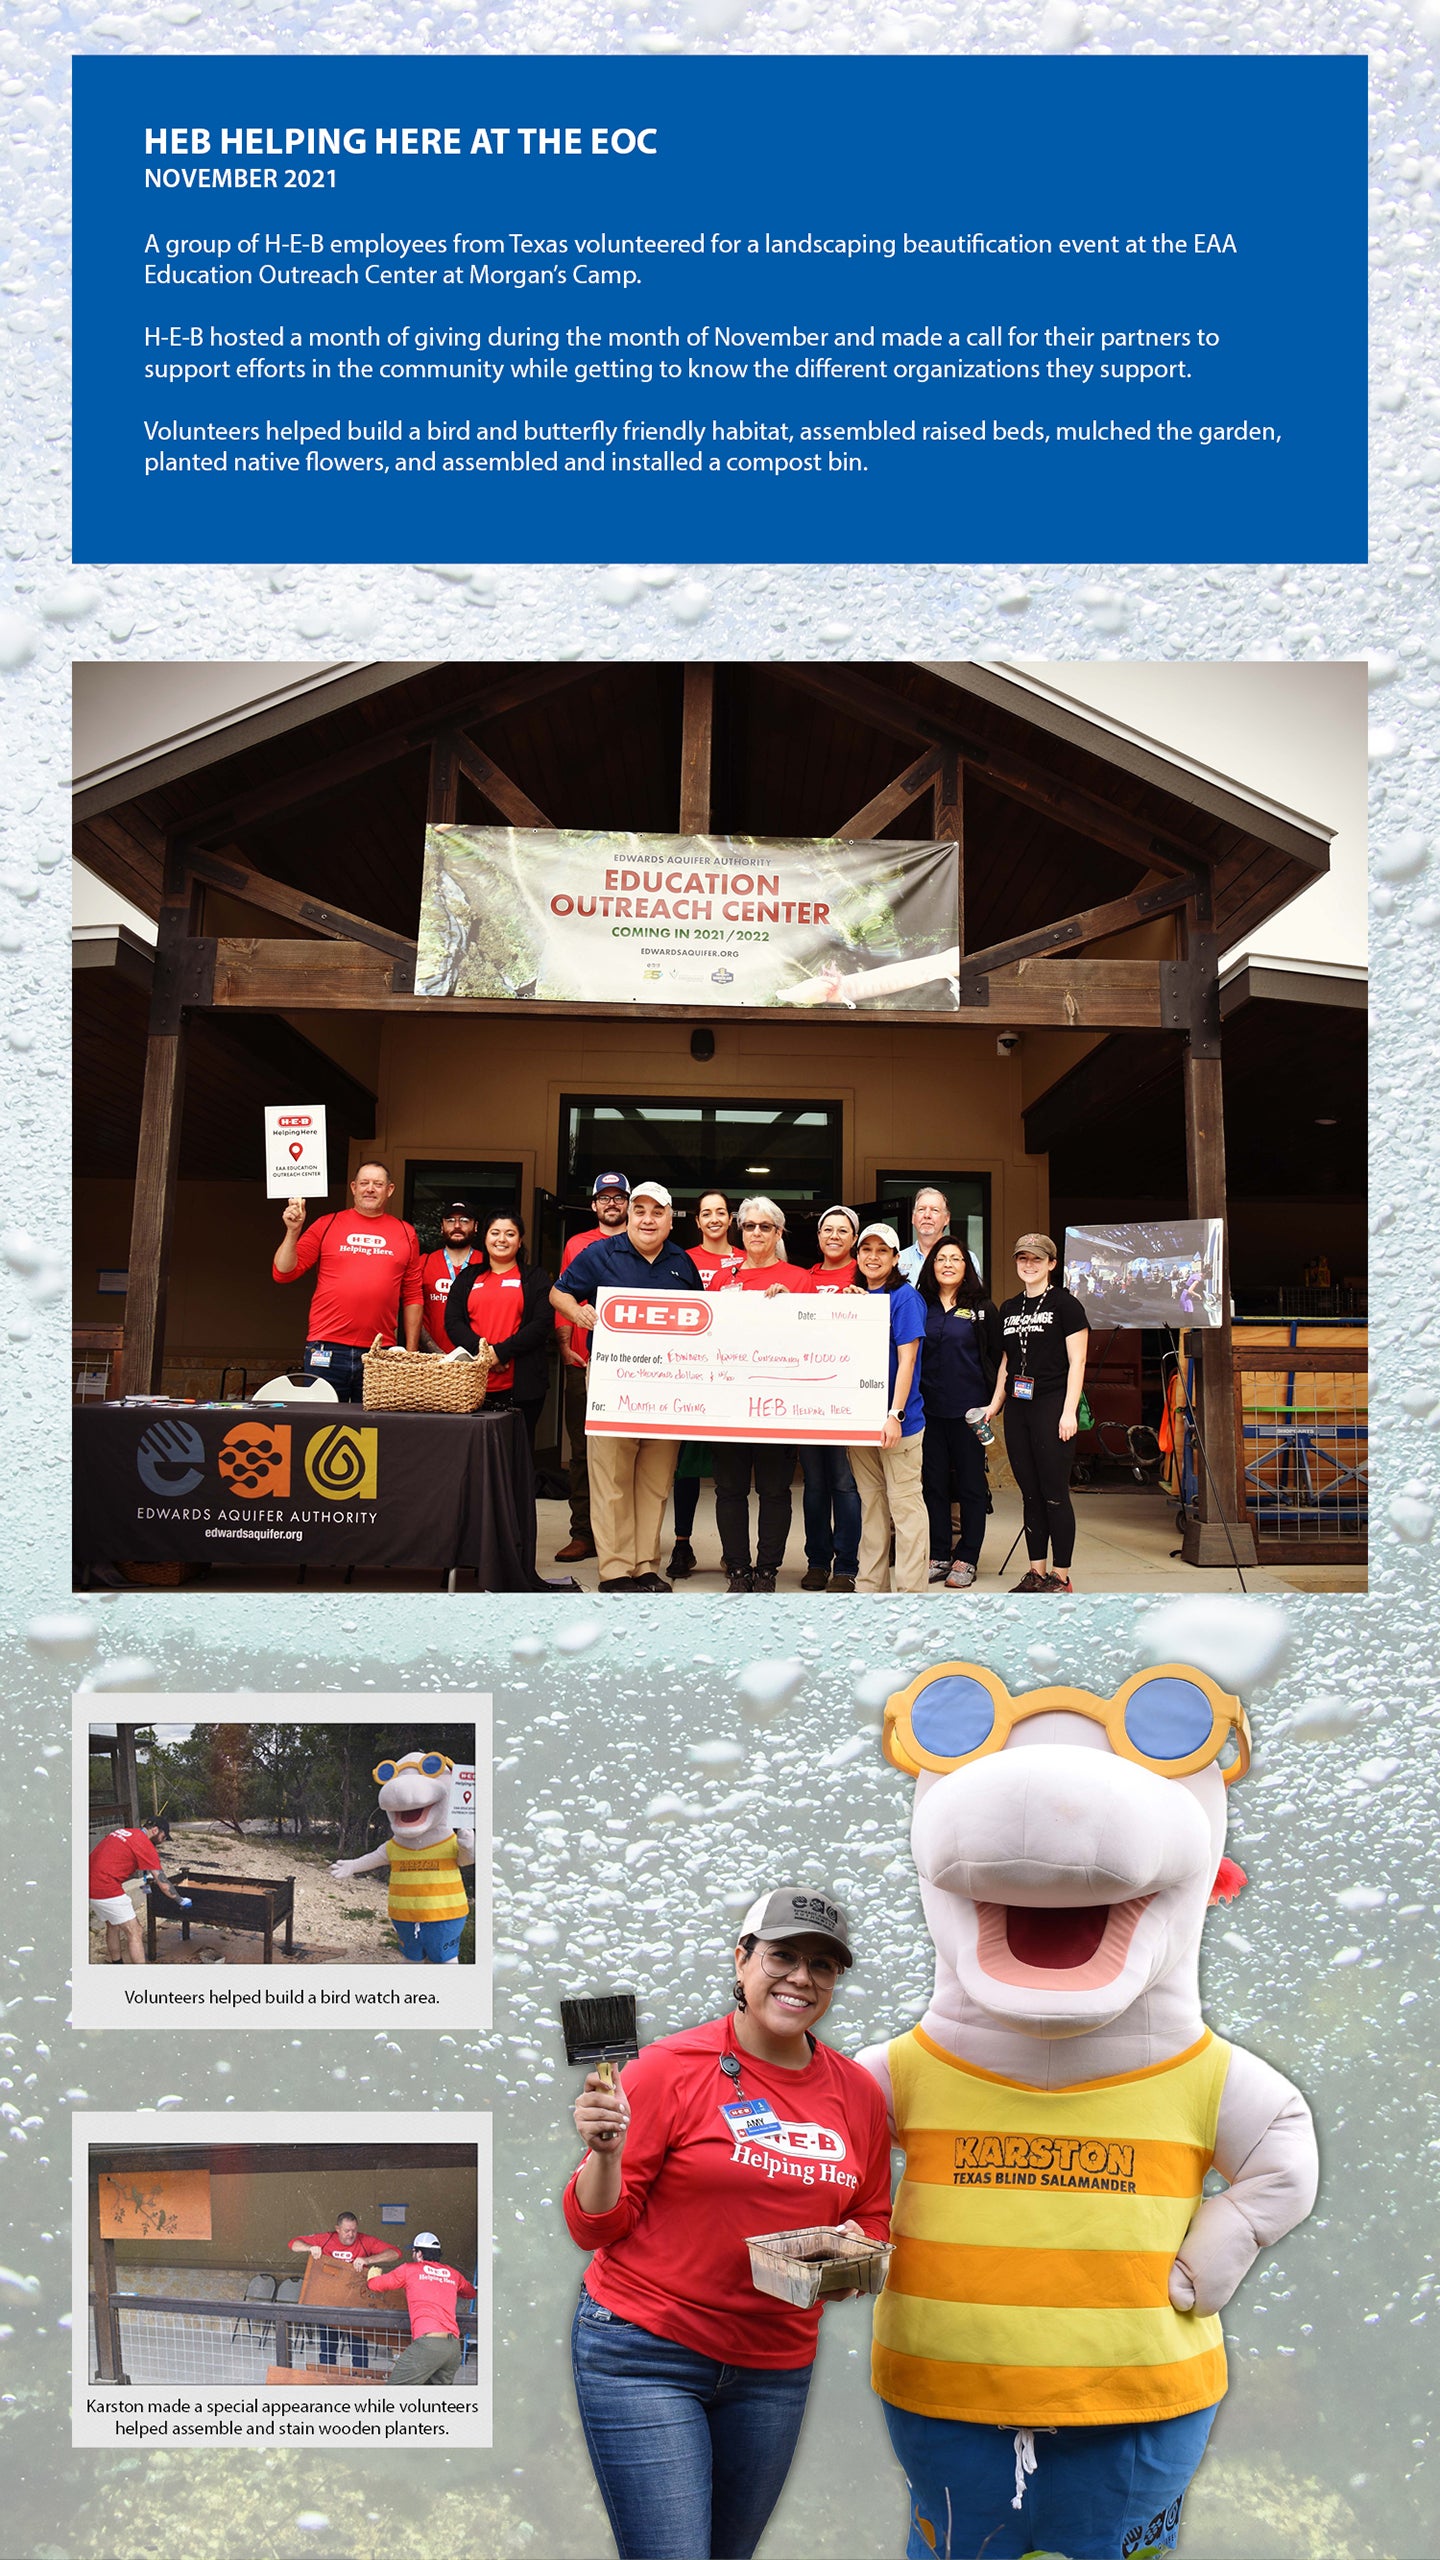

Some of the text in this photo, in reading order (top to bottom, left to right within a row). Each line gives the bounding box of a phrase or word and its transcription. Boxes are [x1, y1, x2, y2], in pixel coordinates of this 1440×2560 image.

[613, 853, 772, 867] EDWARDS AQUIFER AUTHORITY
[604, 868, 780, 897] EDUCATION
[549, 893, 831, 926] OUTREACH CENTER
[611, 926, 770, 944] COMING IN 2021/2022
[640, 947, 740, 958] EDWARDSAQUIFER.ORG
[339, 1245, 372, 1256] Helping
[614, 1304, 701, 1327] H-E-B
[797, 1311, 817, 1321] Date:
[596, 1351, 663, 1365] Pay to the order of:
[859, 1378, 885, 1389] Dollars
[591, 1401, 606, 1412] For:
[136, 1506, 378, 1525] EDWARDS AQUIFER AUTHORITY
[204, 1526, 303, 1542] edwardsaquifer.org
[746, 2117, 766, 2129] AMY
[952, 2136, 1136, 2178] KARSTON
[729, 2142, 857, 2189] Helping Here
[952, 2171, 1138, 2195] TEXAS BLIND SALAMANDER
